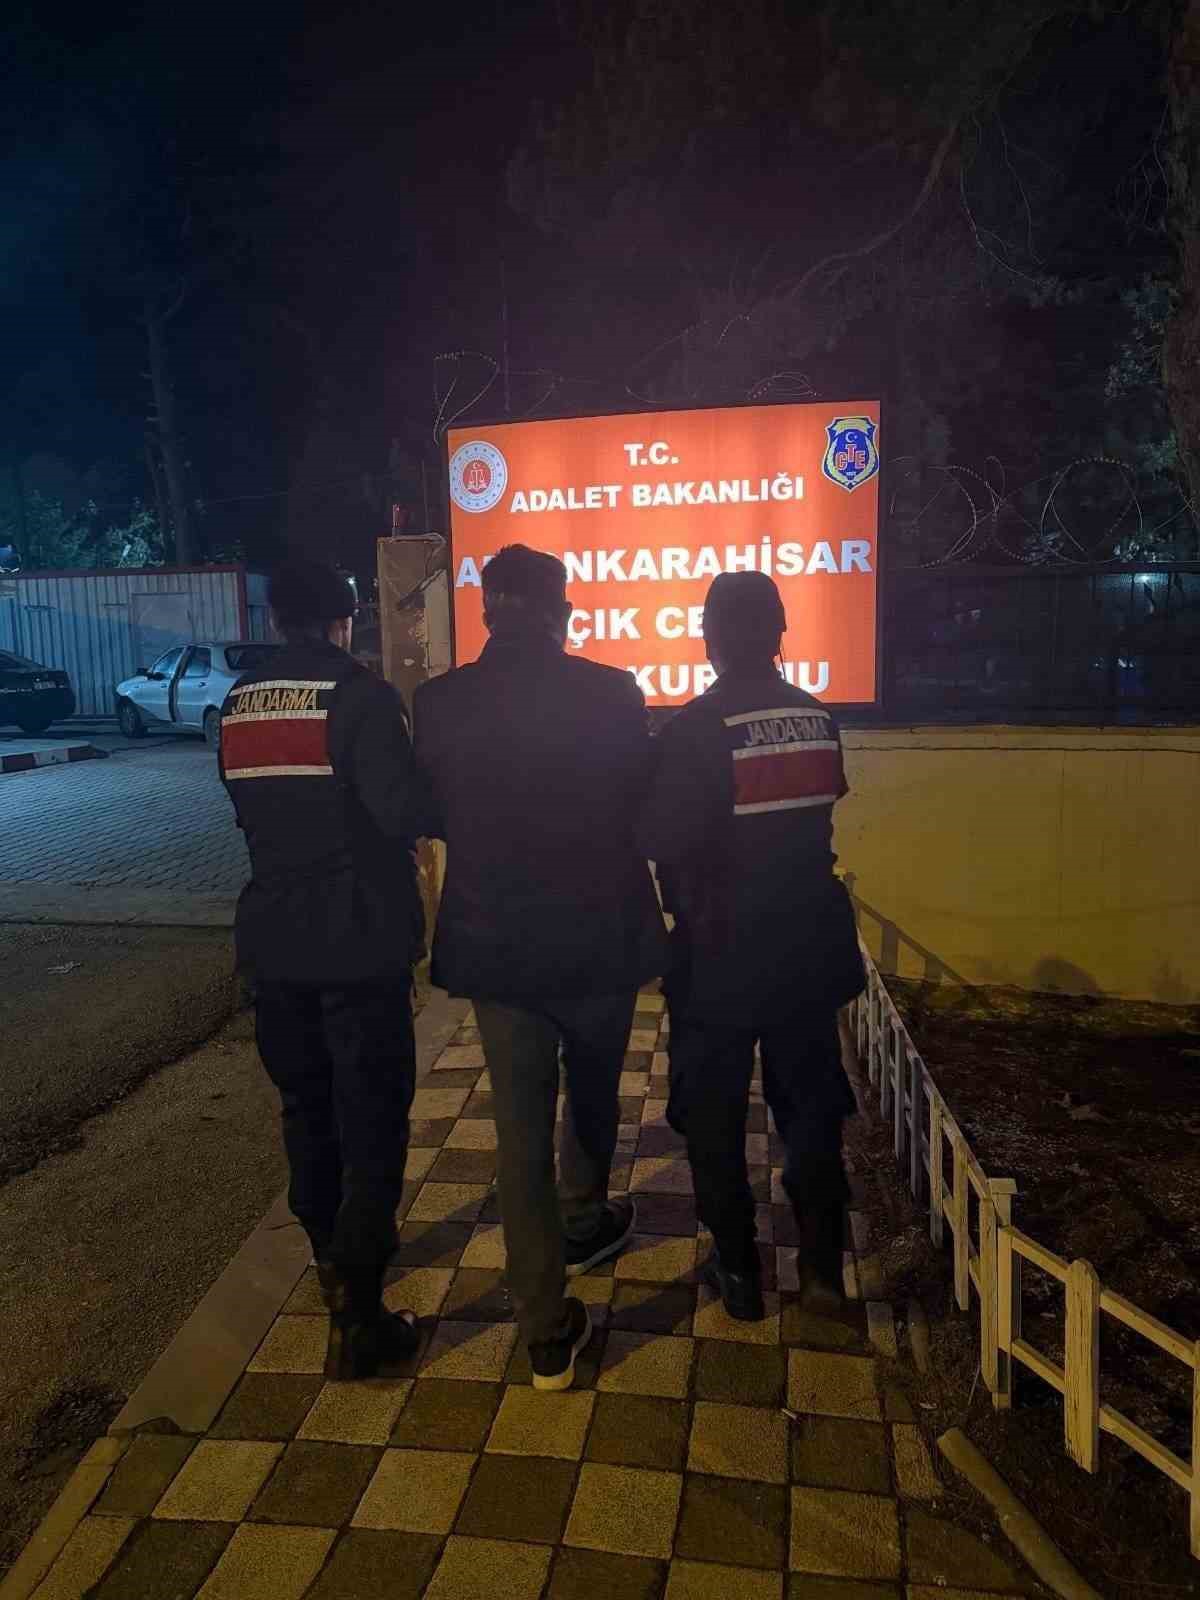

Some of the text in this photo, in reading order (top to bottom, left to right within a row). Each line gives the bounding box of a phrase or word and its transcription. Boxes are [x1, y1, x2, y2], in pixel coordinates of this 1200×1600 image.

[624, 441, 680, 466] T.C.
[510, 472, 804, 513] ADALET BAKANLIĞI
[455, 536, 873, 588] ANKARAHİSAR
[567, 606, 704, 649] ÇIK CE
[627, 661, 830, 697] KURU
[231, 688, 318, 715] JANDARMA
